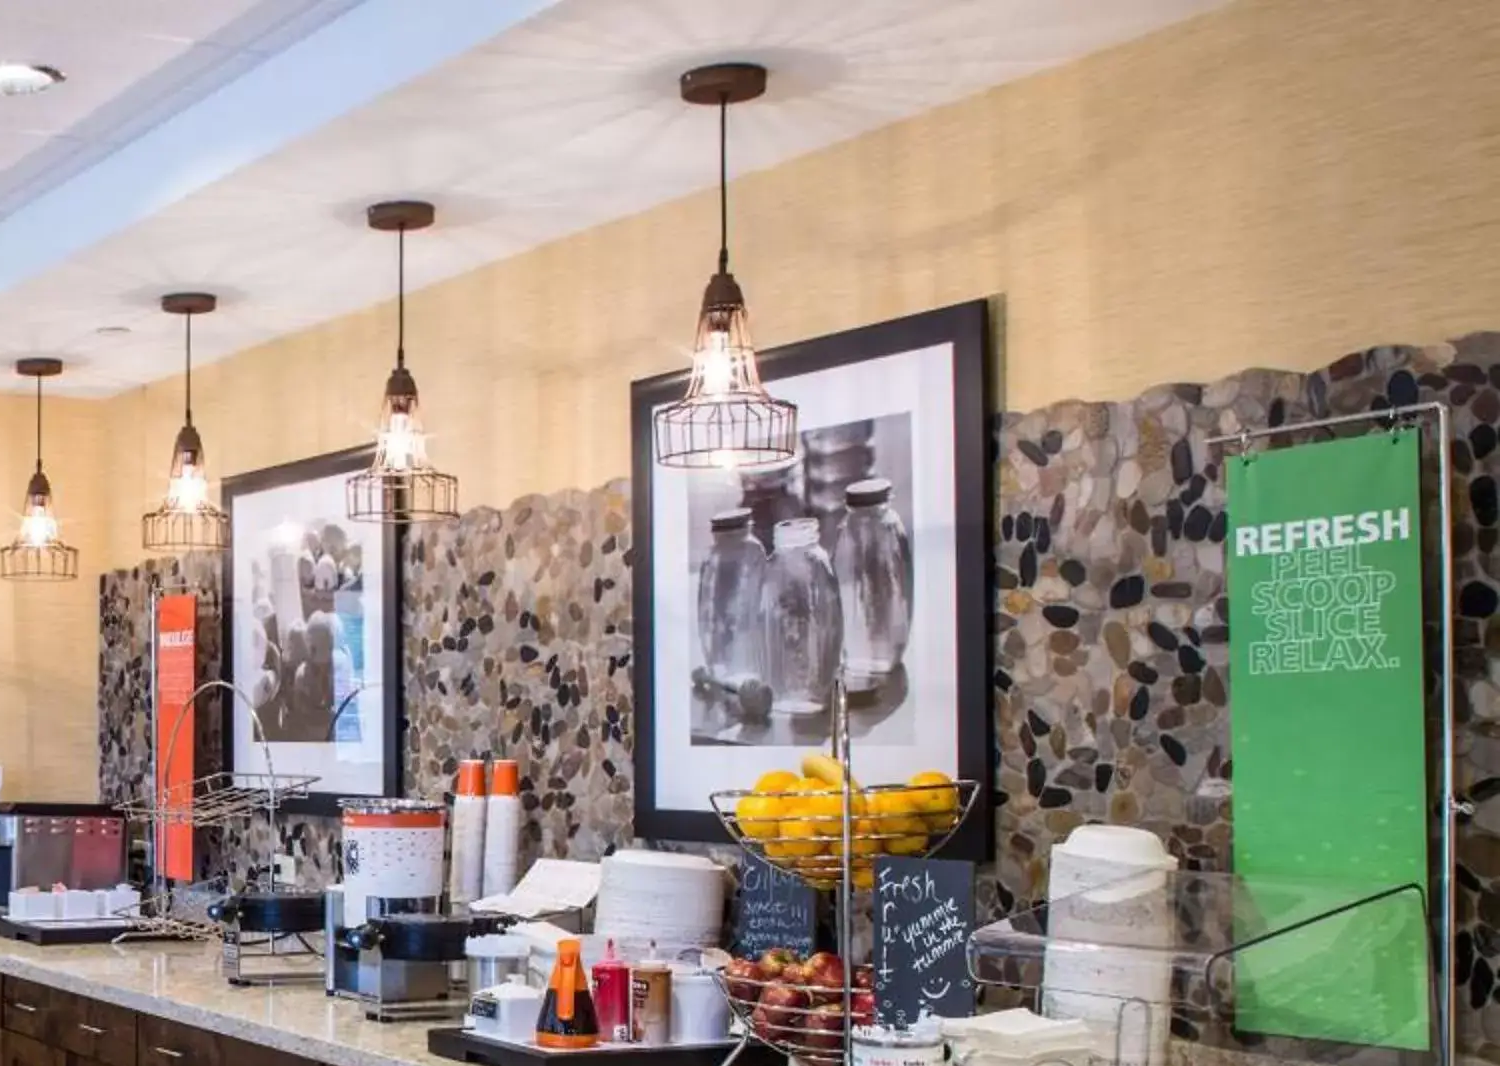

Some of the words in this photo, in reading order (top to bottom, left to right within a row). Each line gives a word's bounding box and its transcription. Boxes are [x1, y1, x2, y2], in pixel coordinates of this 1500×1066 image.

[1236, 507, 1410, 556] REFRESH
[1271, 542, 1373, 582] PEEL
[1251, 570, 1397, 615] SCOOP
[1265, 603, 1382, 643] SLICE
[1249, 634, 1401, 675] RELAX.
[879, 866, 942, 904] Fresh
